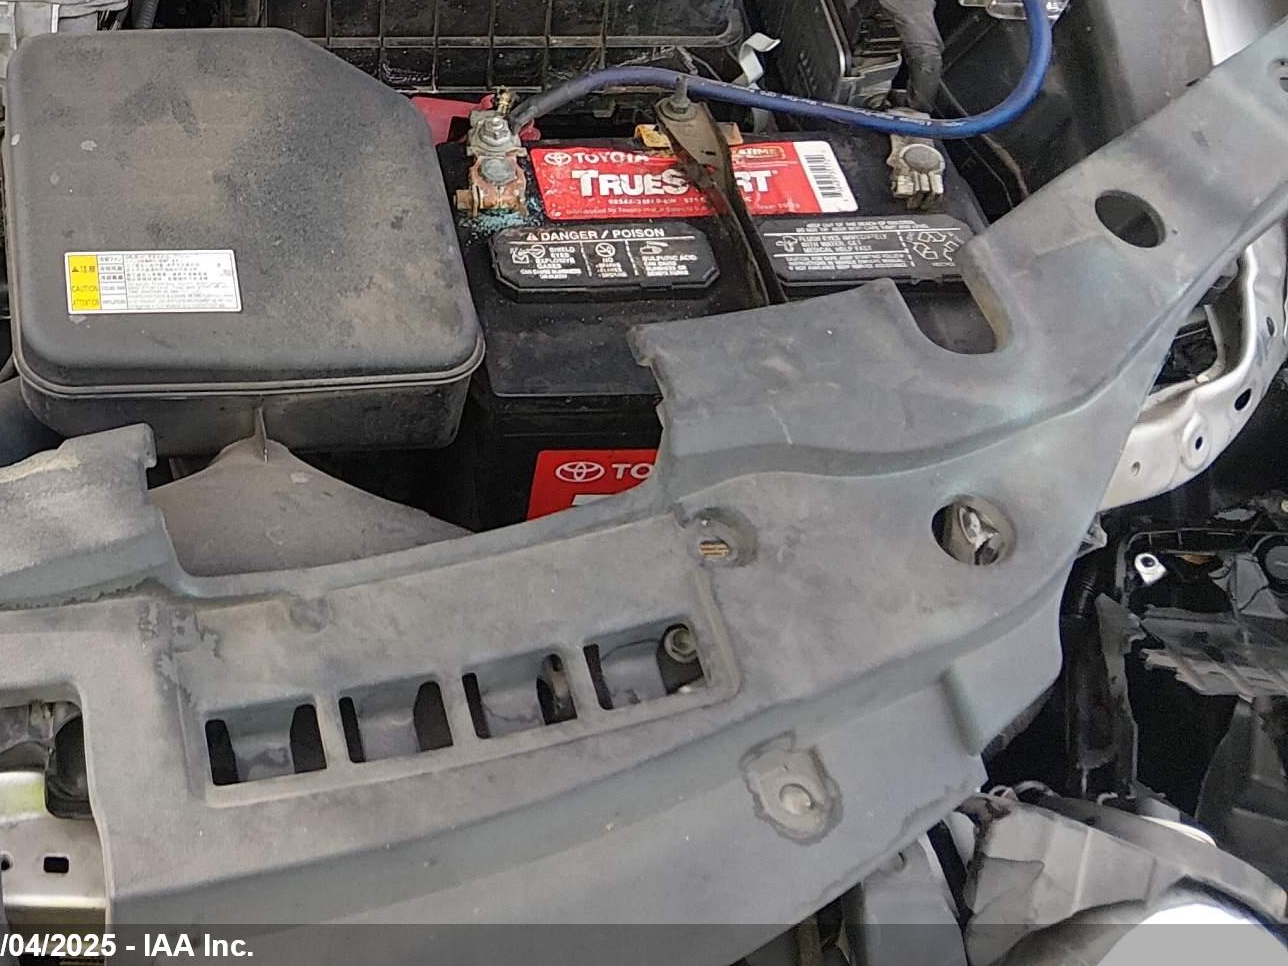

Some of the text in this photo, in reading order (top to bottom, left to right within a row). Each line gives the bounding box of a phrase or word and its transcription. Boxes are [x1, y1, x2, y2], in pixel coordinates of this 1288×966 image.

[571, 168, 772, 197] TRUESRT
[540, 229, 665, 241] DANGER / POISON
